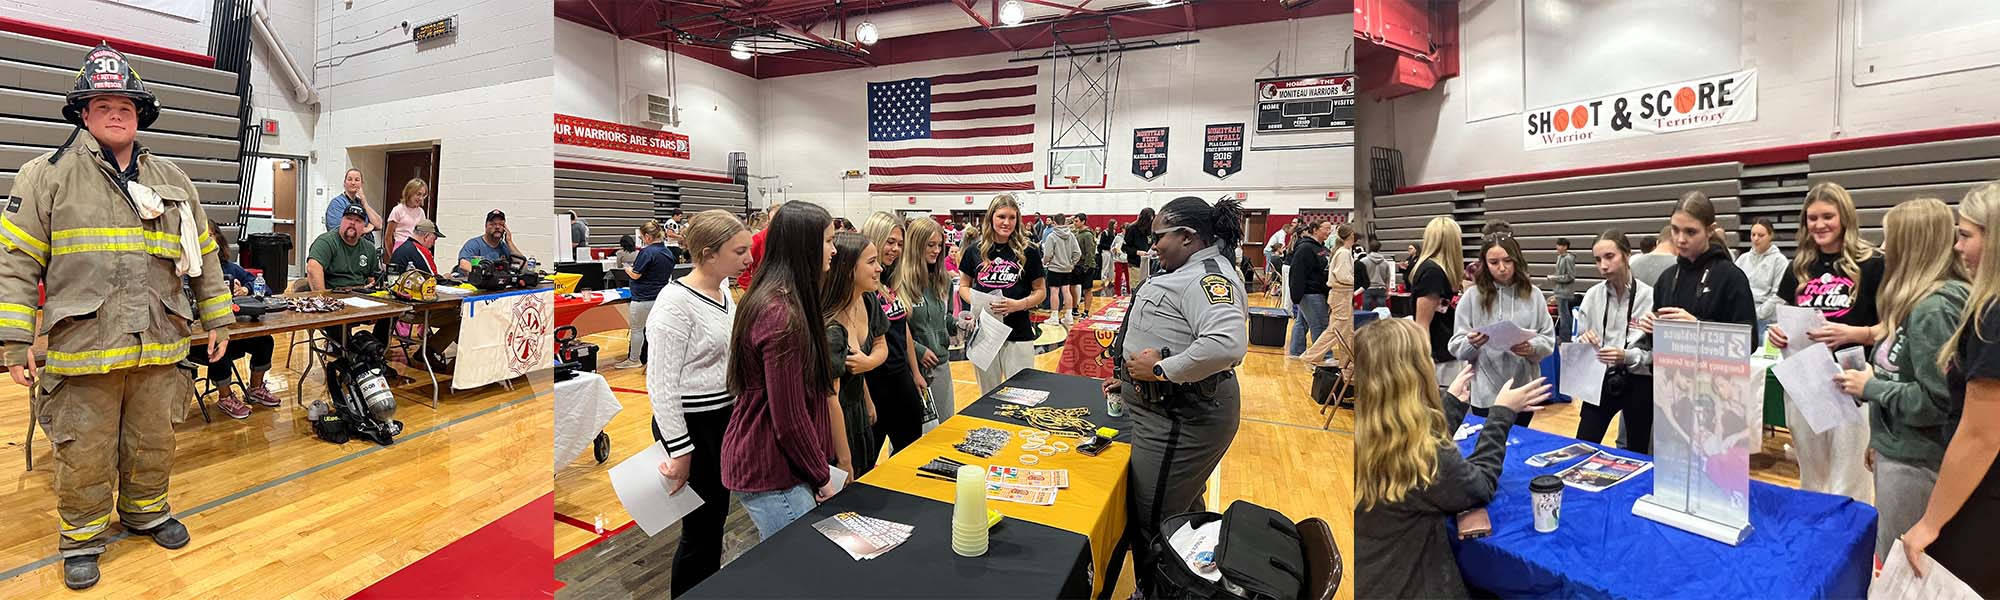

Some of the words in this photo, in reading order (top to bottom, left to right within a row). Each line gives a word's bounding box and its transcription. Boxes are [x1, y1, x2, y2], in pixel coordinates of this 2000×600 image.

[94, 58, 119, 73] 30
[1279, 89, 1307, 98] MONITEAU
[1308, 87, 1339, 97] WARRIORS
[1611, 98, 1632, 131] &
[1542, 131, 1594, 144] Warrior
[1653, 111, 1726, 129] Territory
[574, 125, 627, 143] WARRIORS
[630, 135, 648, 146] ARE
[650, 138, 677, 150] STARS
[1213, 152, 1232, 160] 2016
[998, 273, 1018, 281] CURE
[1814, 295, 1823, 306] A
[1097, 330, 1112, 339] GU
